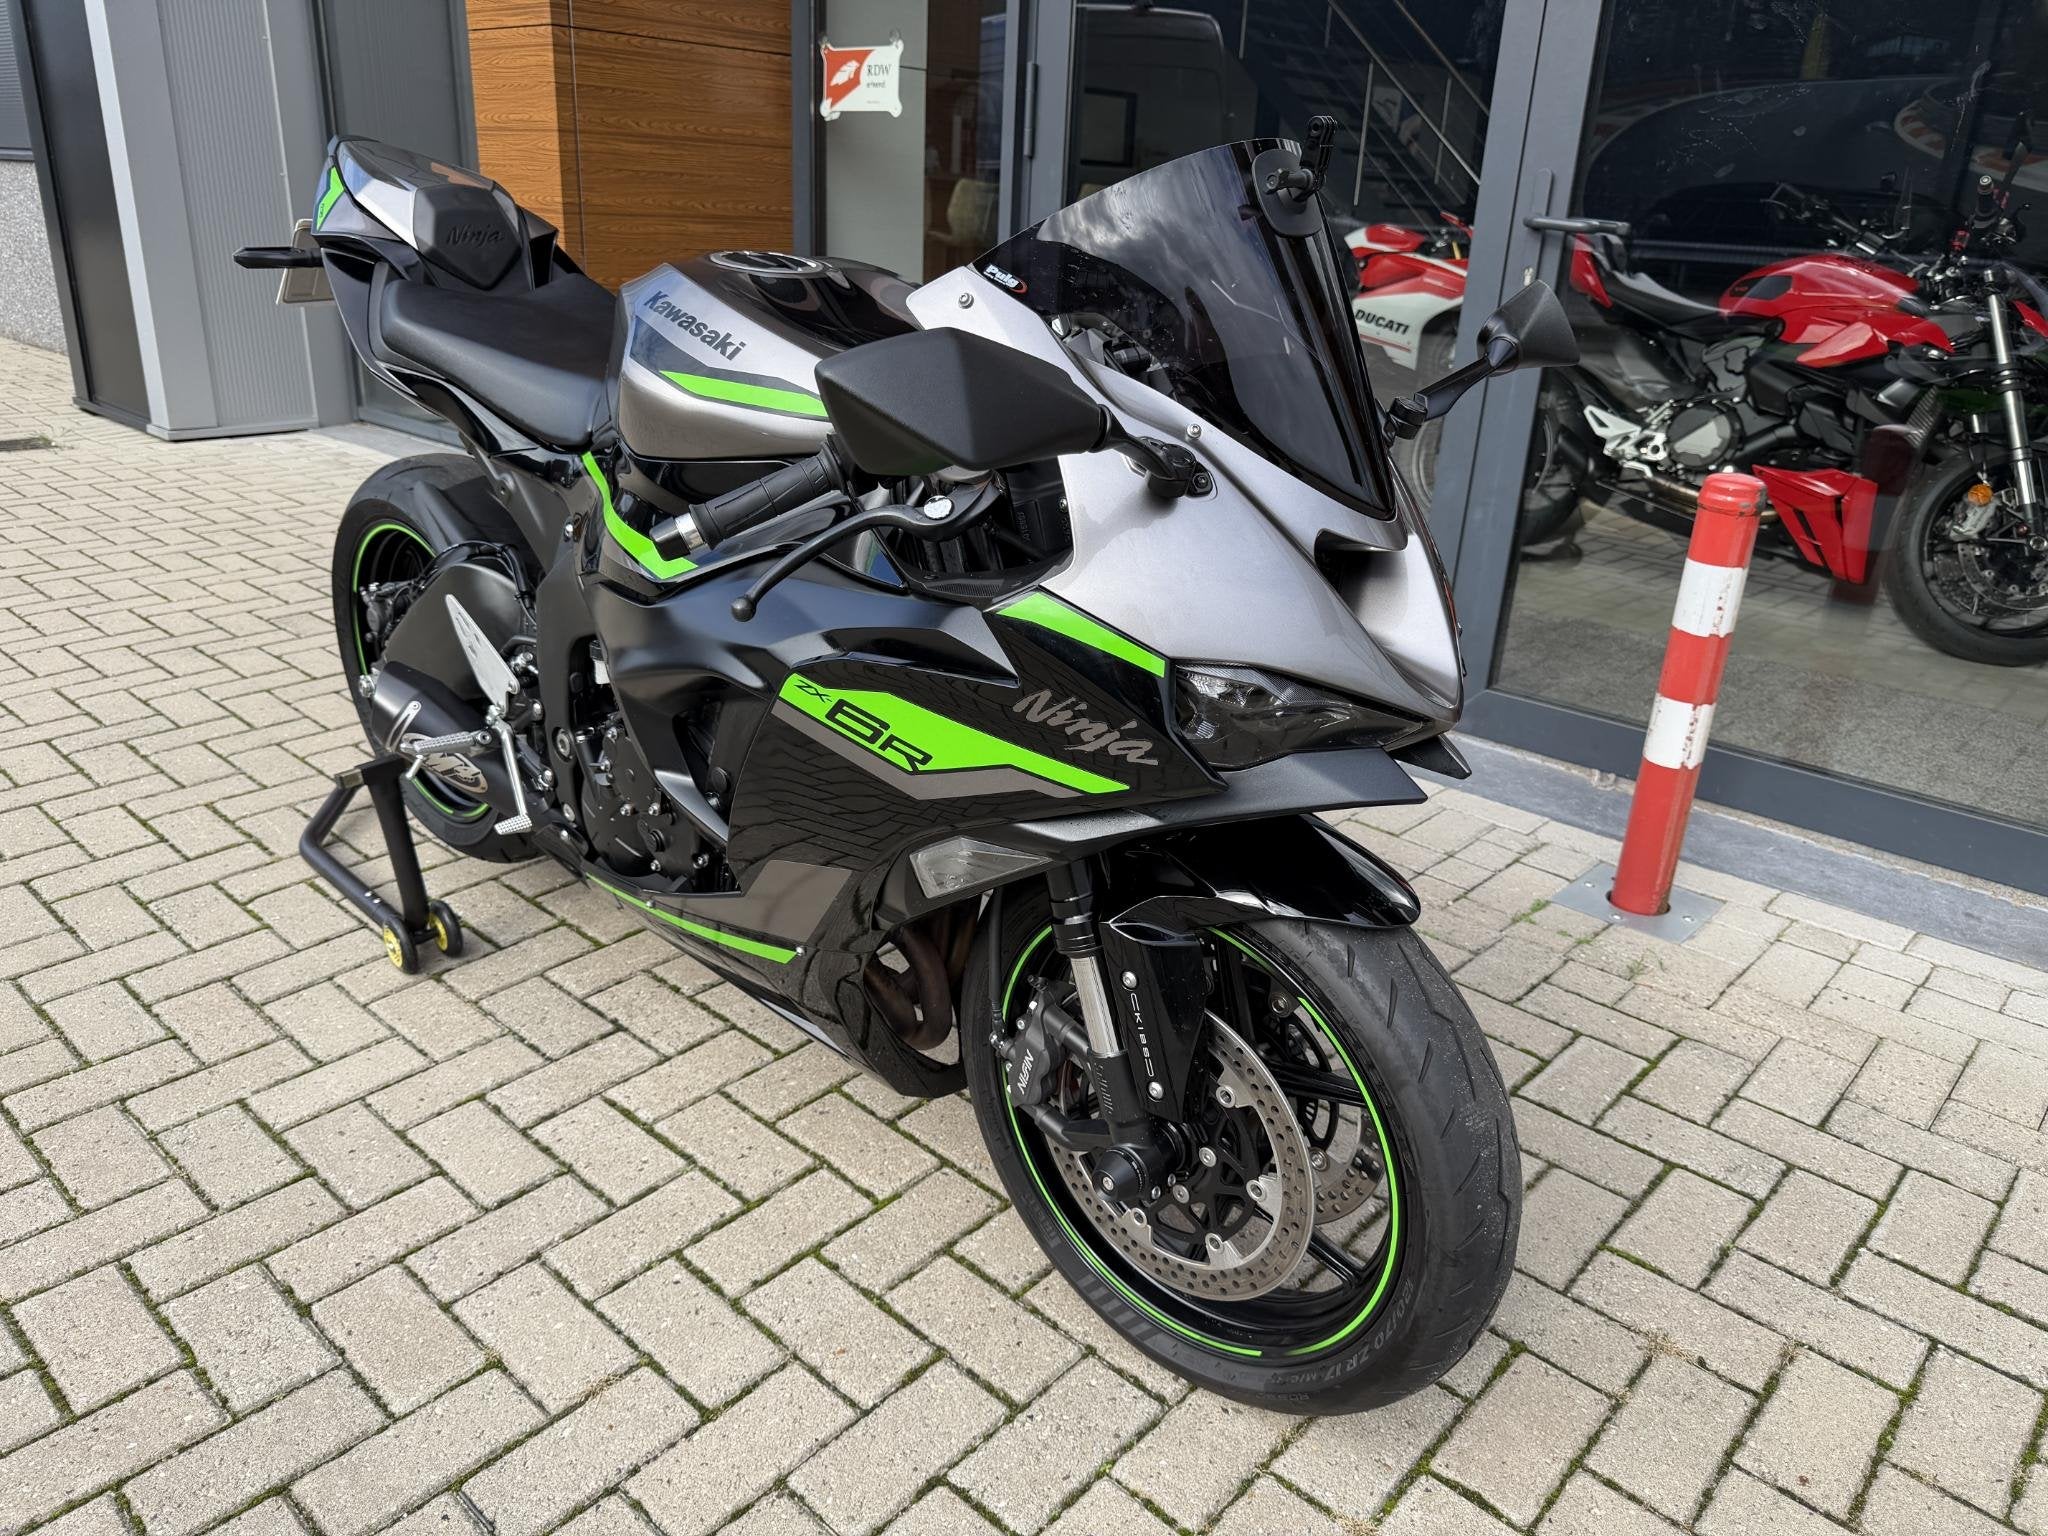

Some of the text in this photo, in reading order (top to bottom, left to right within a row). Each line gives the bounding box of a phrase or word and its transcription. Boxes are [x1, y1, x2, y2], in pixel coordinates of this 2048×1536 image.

[866, 64, 892, 77] RDW
[446, 223, 504, 249] Ninja
[643, 290, 747, 361] Kawasaki
[1354, 308, 1410, 335] DUCATI
[1012, 688, 1159, 767] Ninja
